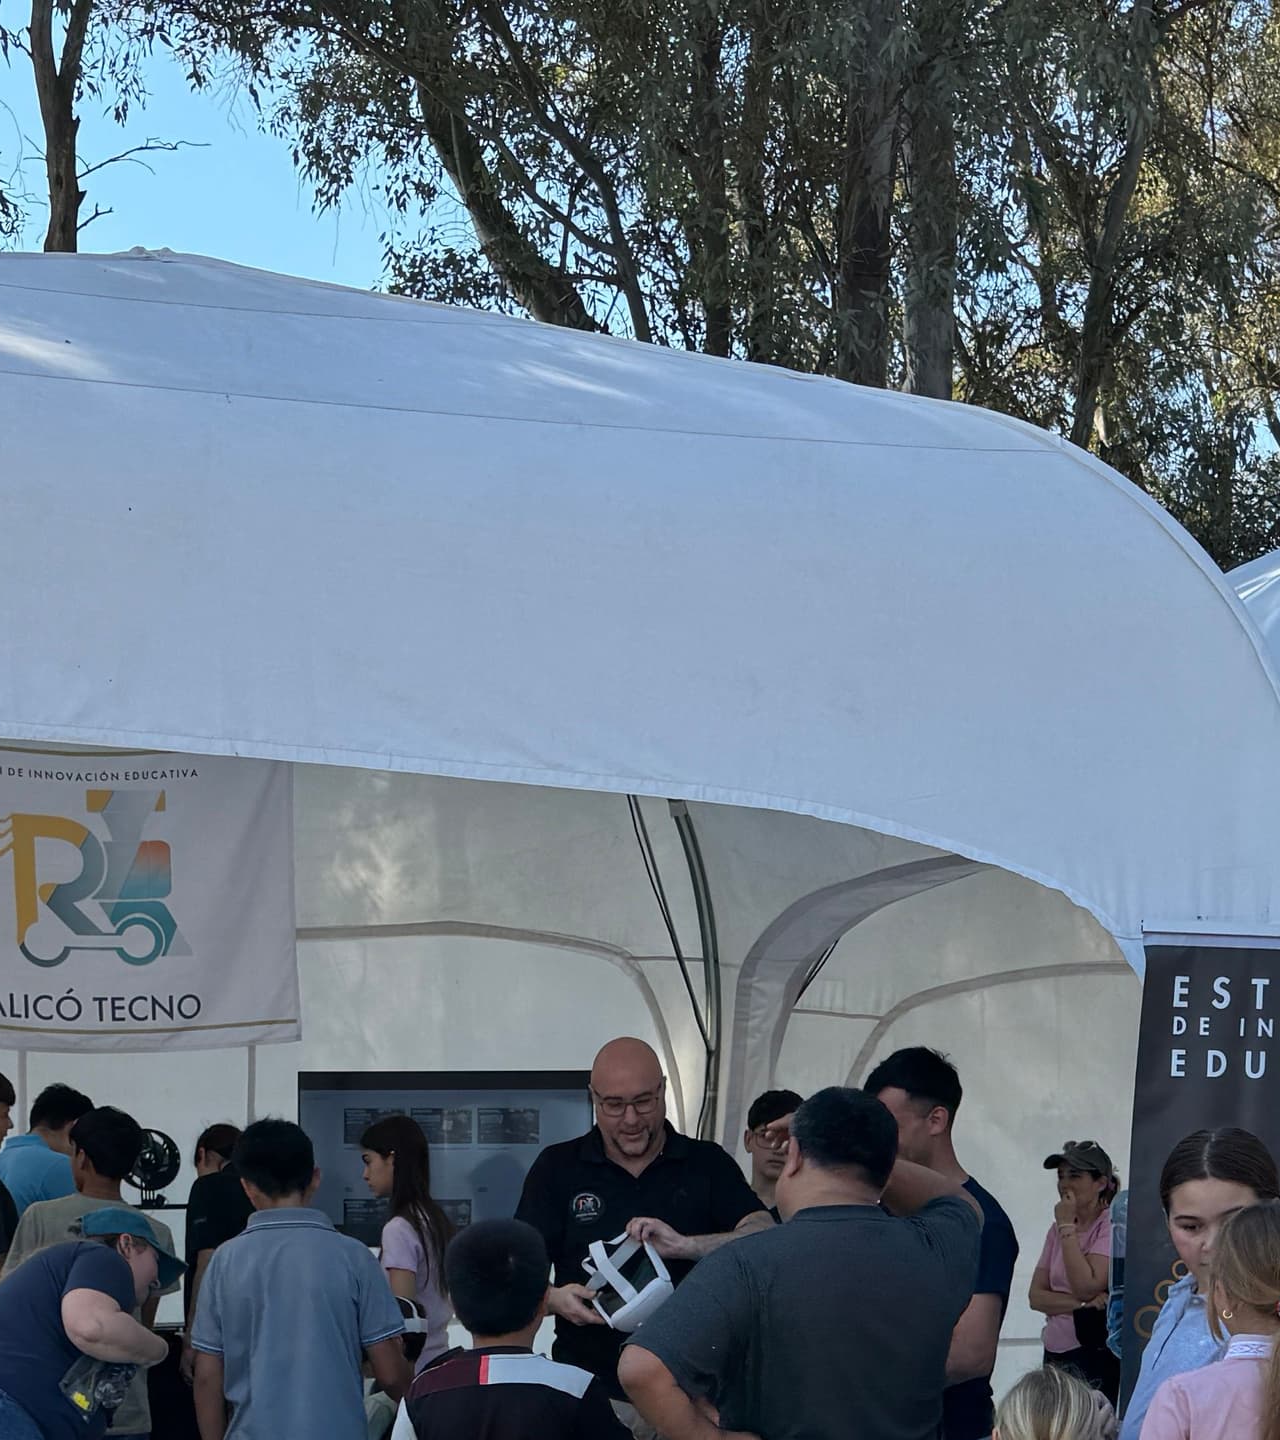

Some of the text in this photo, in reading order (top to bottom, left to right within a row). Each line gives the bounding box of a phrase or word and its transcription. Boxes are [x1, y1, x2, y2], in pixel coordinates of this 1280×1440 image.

[7, 767, 24, 778] DE
[28, 769, 120, 783] INNOVACIÓN
[124, 768, 199, 782] EDUCATIVA
[92, 993, 202, 1022] TECNO
[1172, 1016, 1210, 1036] DE
